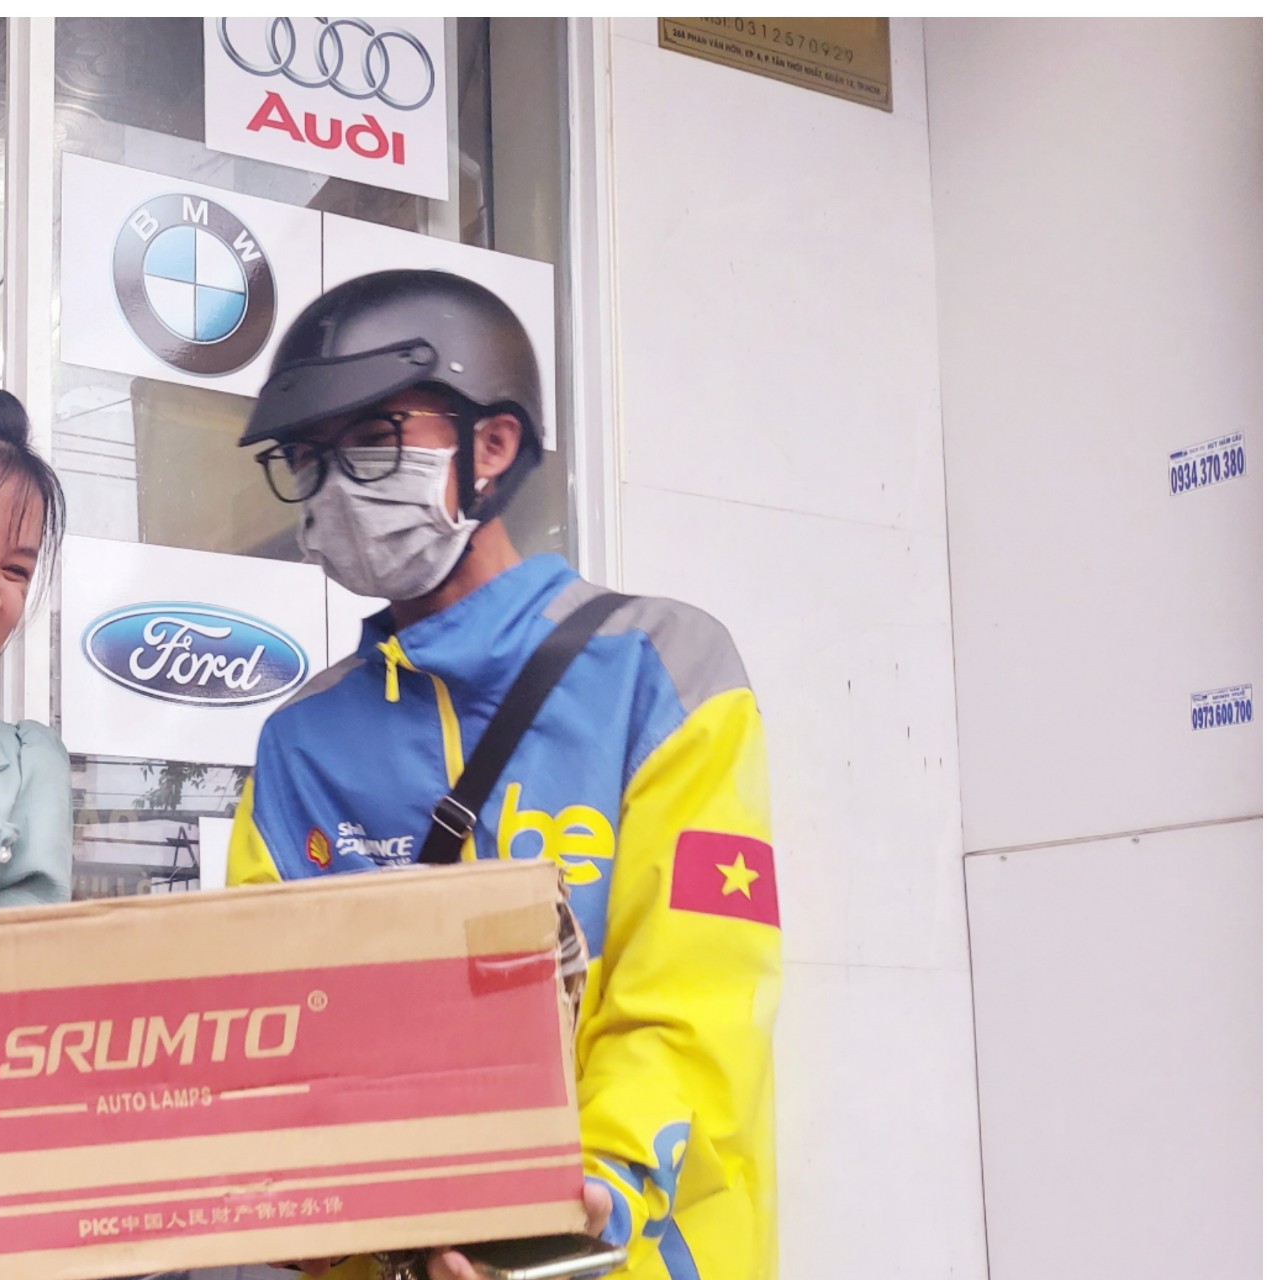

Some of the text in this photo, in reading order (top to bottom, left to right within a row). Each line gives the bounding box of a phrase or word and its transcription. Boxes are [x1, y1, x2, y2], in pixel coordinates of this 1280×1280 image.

[246, 91, 405, 166] Audi
[129, 196, 261, 263] BMW
[1170, 446, 1245, 494] 0934.370.380
[128, 615, 266, 691] Ford
[497, 782, 616, 885] be
[96, 1086, 213, 1116] AUTO LAMPS
